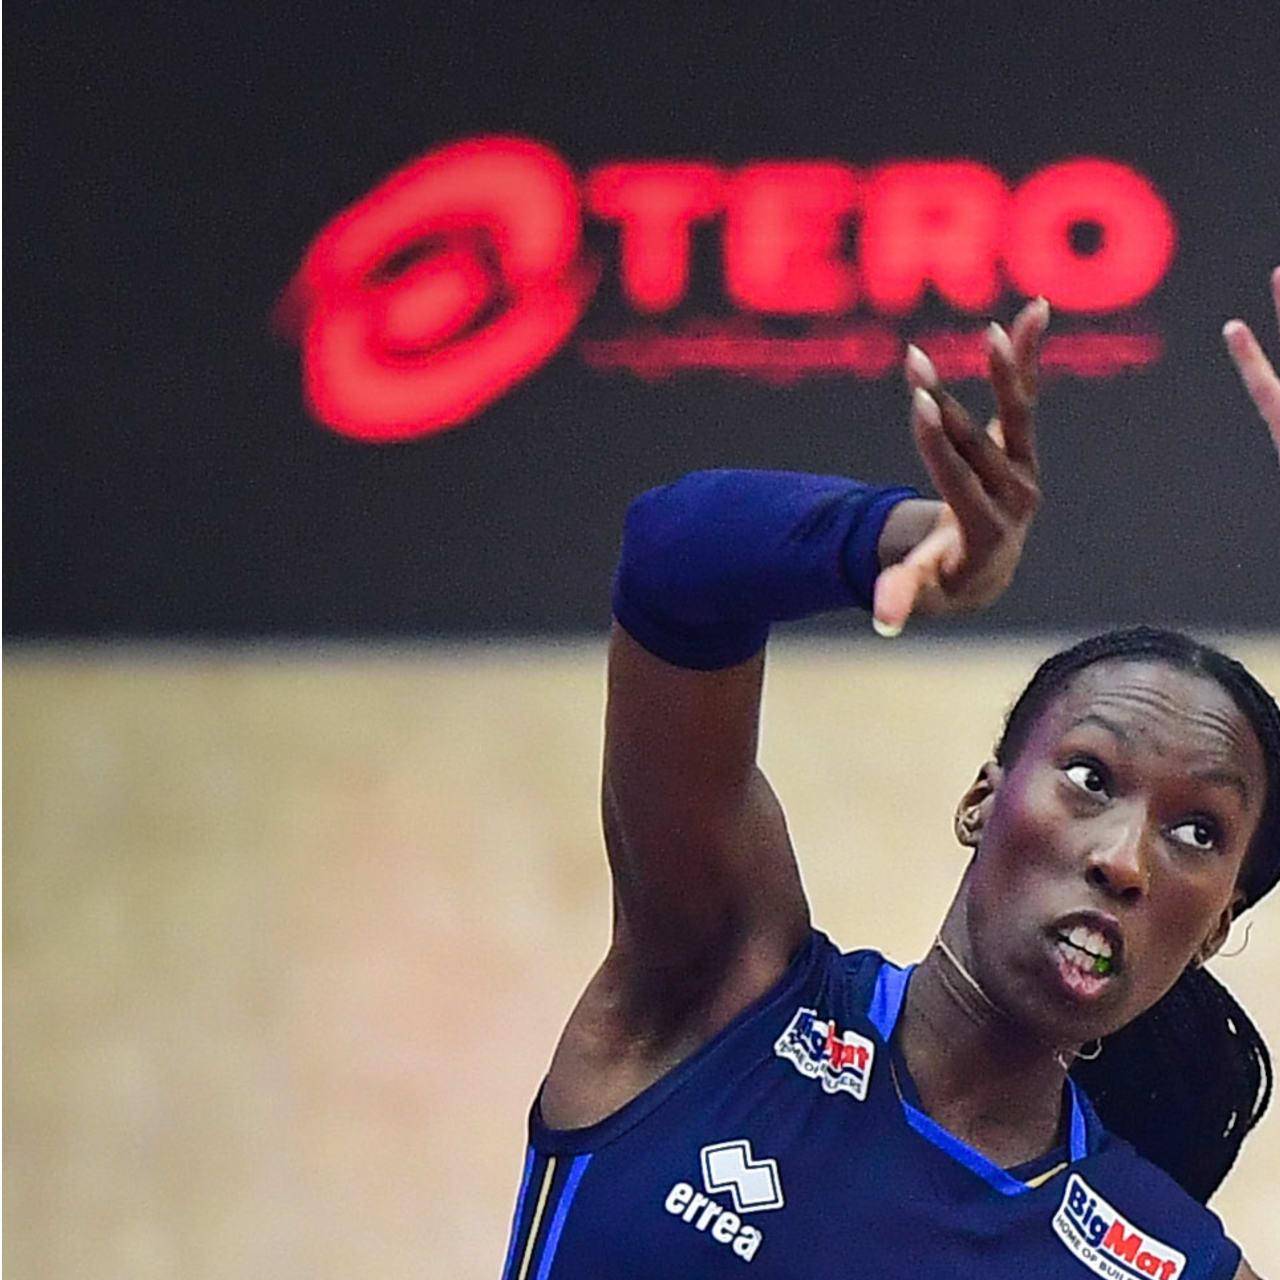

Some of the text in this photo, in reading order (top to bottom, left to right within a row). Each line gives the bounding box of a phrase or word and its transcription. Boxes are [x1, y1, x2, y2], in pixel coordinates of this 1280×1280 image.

[588, 156, 1176, 313] TERO
[665, 1182, 762, 1262] errea
[1056, 1214, 1081, 1250] HOME
[1081, 1247, 1098, 1262] OF
